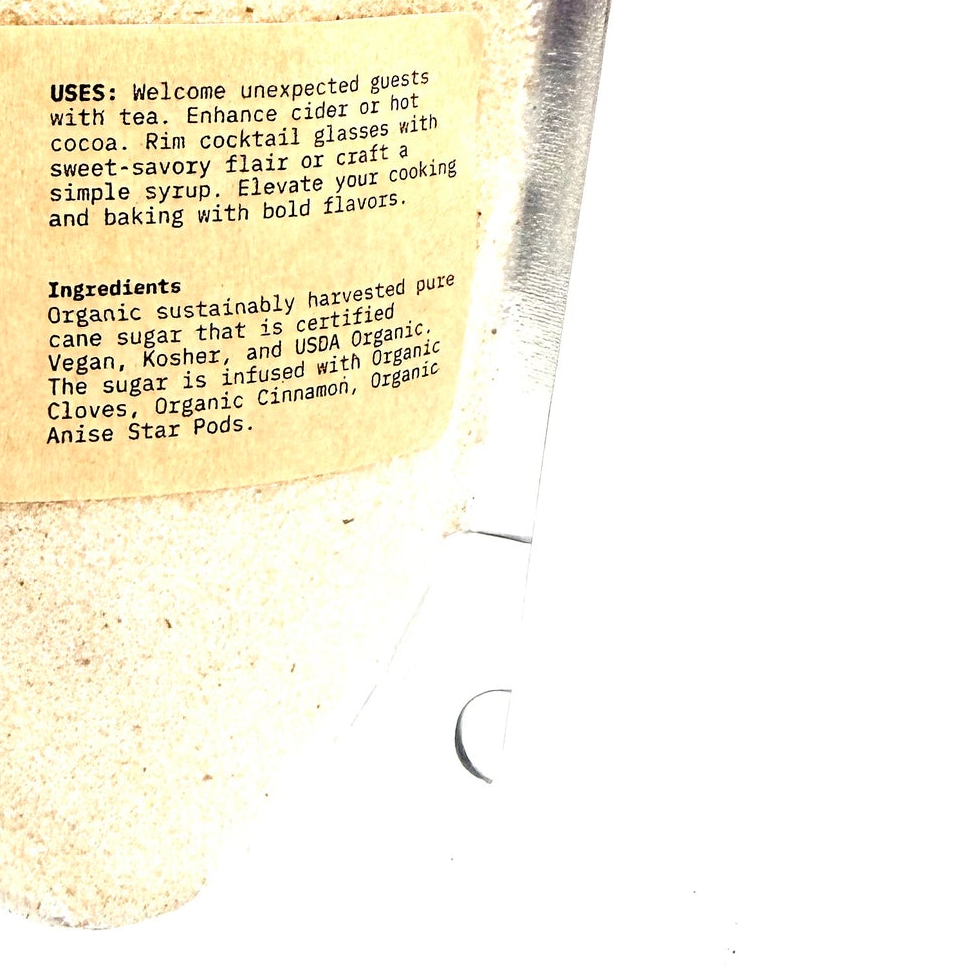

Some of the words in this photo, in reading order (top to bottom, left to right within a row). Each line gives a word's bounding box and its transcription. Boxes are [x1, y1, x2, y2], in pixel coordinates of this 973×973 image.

[50, 83, 116, 103] USES:
[132, 80, 227, 102] Welcome
[240, 73, 359, 102] unexpected
[370, 69, 429, 95] guests
[49, 107, 105, 127] with
[119, 108, 169, 126] tea.
[186, 105, 278, 124] Enhance
[291, 100, 349, 122] cider
[359, 100, 381, 115] or
[390, 92, 420, 112] hot
[50, 137, 128, 153] cocoa.
[145, 131, 186, 151] Rim
[199, 126, 300, 150] cocktail
[313, 123, 389, 148] glasses
[398, 113, 438, 135] with
[50, 158, 211, 179] sweet-savory
[225, 152, 289, 174] flair
[300, 154, 325, 169] or
[336, 143, 389, 166] craft
[398, 144, 409, 159] a
[49, 181, 131, 206] simple
[145, 184, 221, 205] syrup.
[238, 175, 324, 198] Elevate
[335, 171, 379, 194] your
[388, 158, 458, 183] cooking
[48, 206, 89, 228] and
[104, 205, 185, 229] baking
[197, 202, 249, 224] with
[262, 197, 311, 220] bold
[323, 192, 406, 215] flavors.
[47, 302, 142, 328] Organic
[156, 293, 295, 323] sustainably
[308, 277, 406, 310] harvested
[416, 273, 455, 296] pure
[48, 278, 182, 302] Ingredients
[49, 332, 103, 349] cane
[117, 328, 183, 350] sugar
[195, 321, 246, 342] that
[259, 318, 283, 337] is
[296, 301, 395, 333] certified
[47, 353, 125, 376] Vegan,
[142, 347, 230, 368] Kosher,
[246, 339, 282, 361] and
[295, 333, 341, 355] USDA
[47, 377, 88, 396] The
[102, 376, 169, 398] sugar
[183, 370, 207, 390] is
[221, 360, 305, 387] infused
[316, 352, 361, 376] with
[371, 340, 441, 367] Organic
[47, 400, 138, 421] Cloves,
[155, 390, 244, 418] Organic
[257, 380, 357, 406] Cinnamon,
[370, 362, 440, 389] Organic
[45, 424, 114, 445] Anise
[128, 422, 181, 441] Star
[193, 414, 253, 436] Pods.
